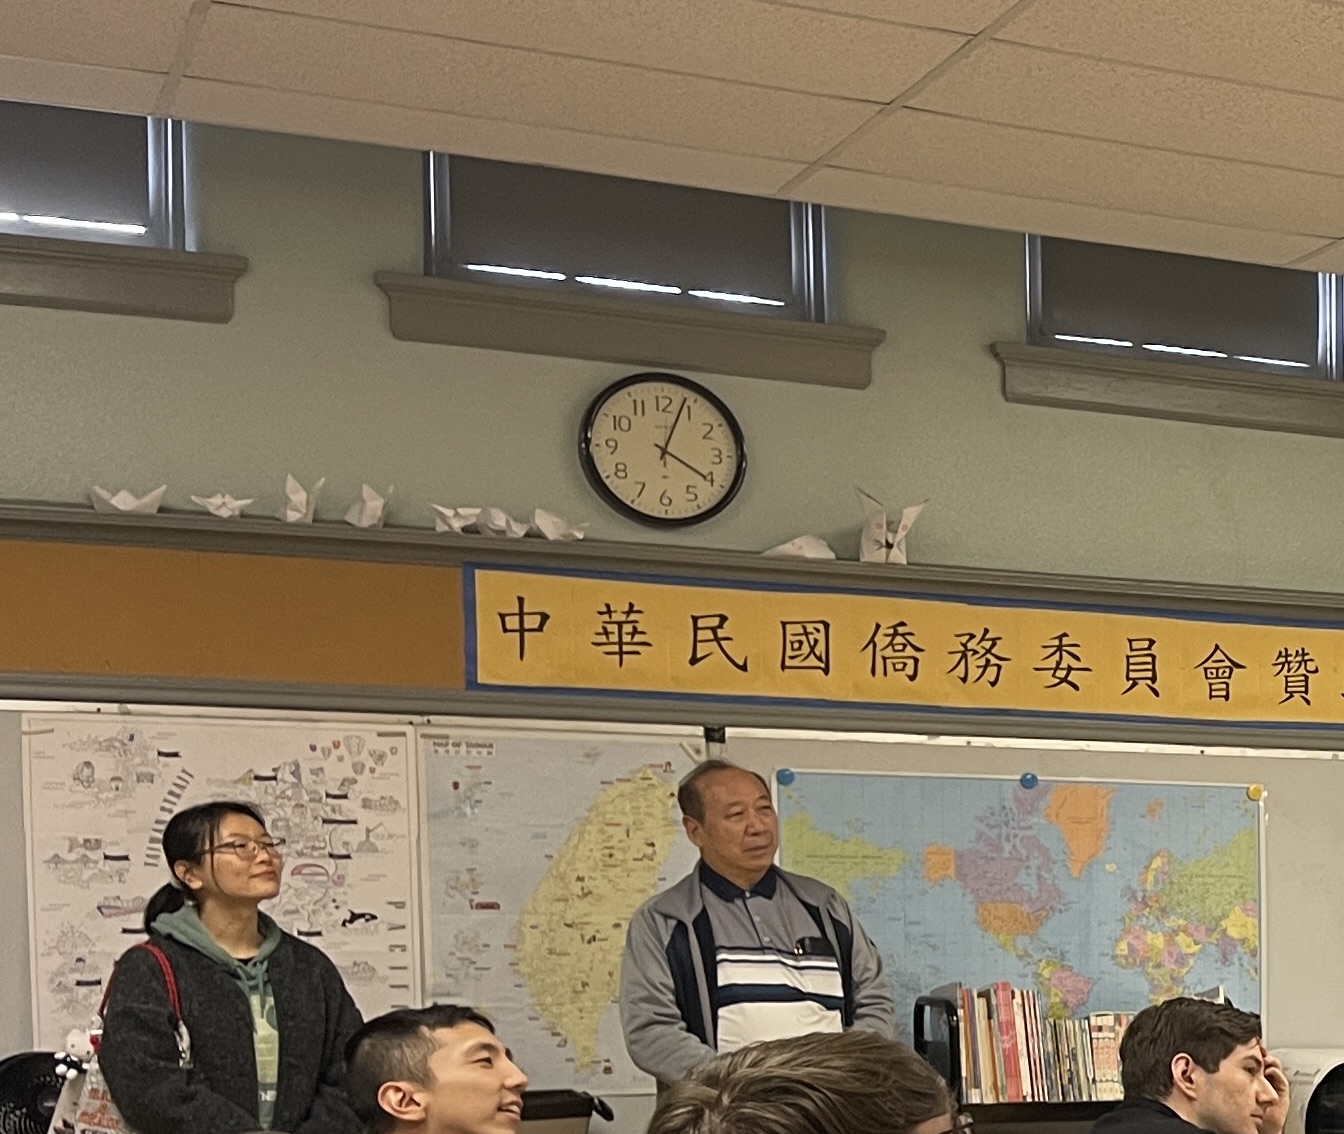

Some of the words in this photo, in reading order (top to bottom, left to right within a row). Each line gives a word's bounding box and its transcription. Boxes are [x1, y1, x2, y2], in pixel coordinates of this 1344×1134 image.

[632, 399, 646, 417] 11
[655, 395, 673, 413] 12
[686, 404, 692, 422] 1
[612, 415, 632, 432] 10
[702, 422, 714, 440] 2
[605, 438, 618, 456] 9
[711, 448, 723, 465] 3
[614, 462, 628, 479] 8
[704, 471, 714, 487] 4
[634, 481, 646, 498] 7
[659, 489, 673, 507] 6
[686, 485, 698, 502] 5
